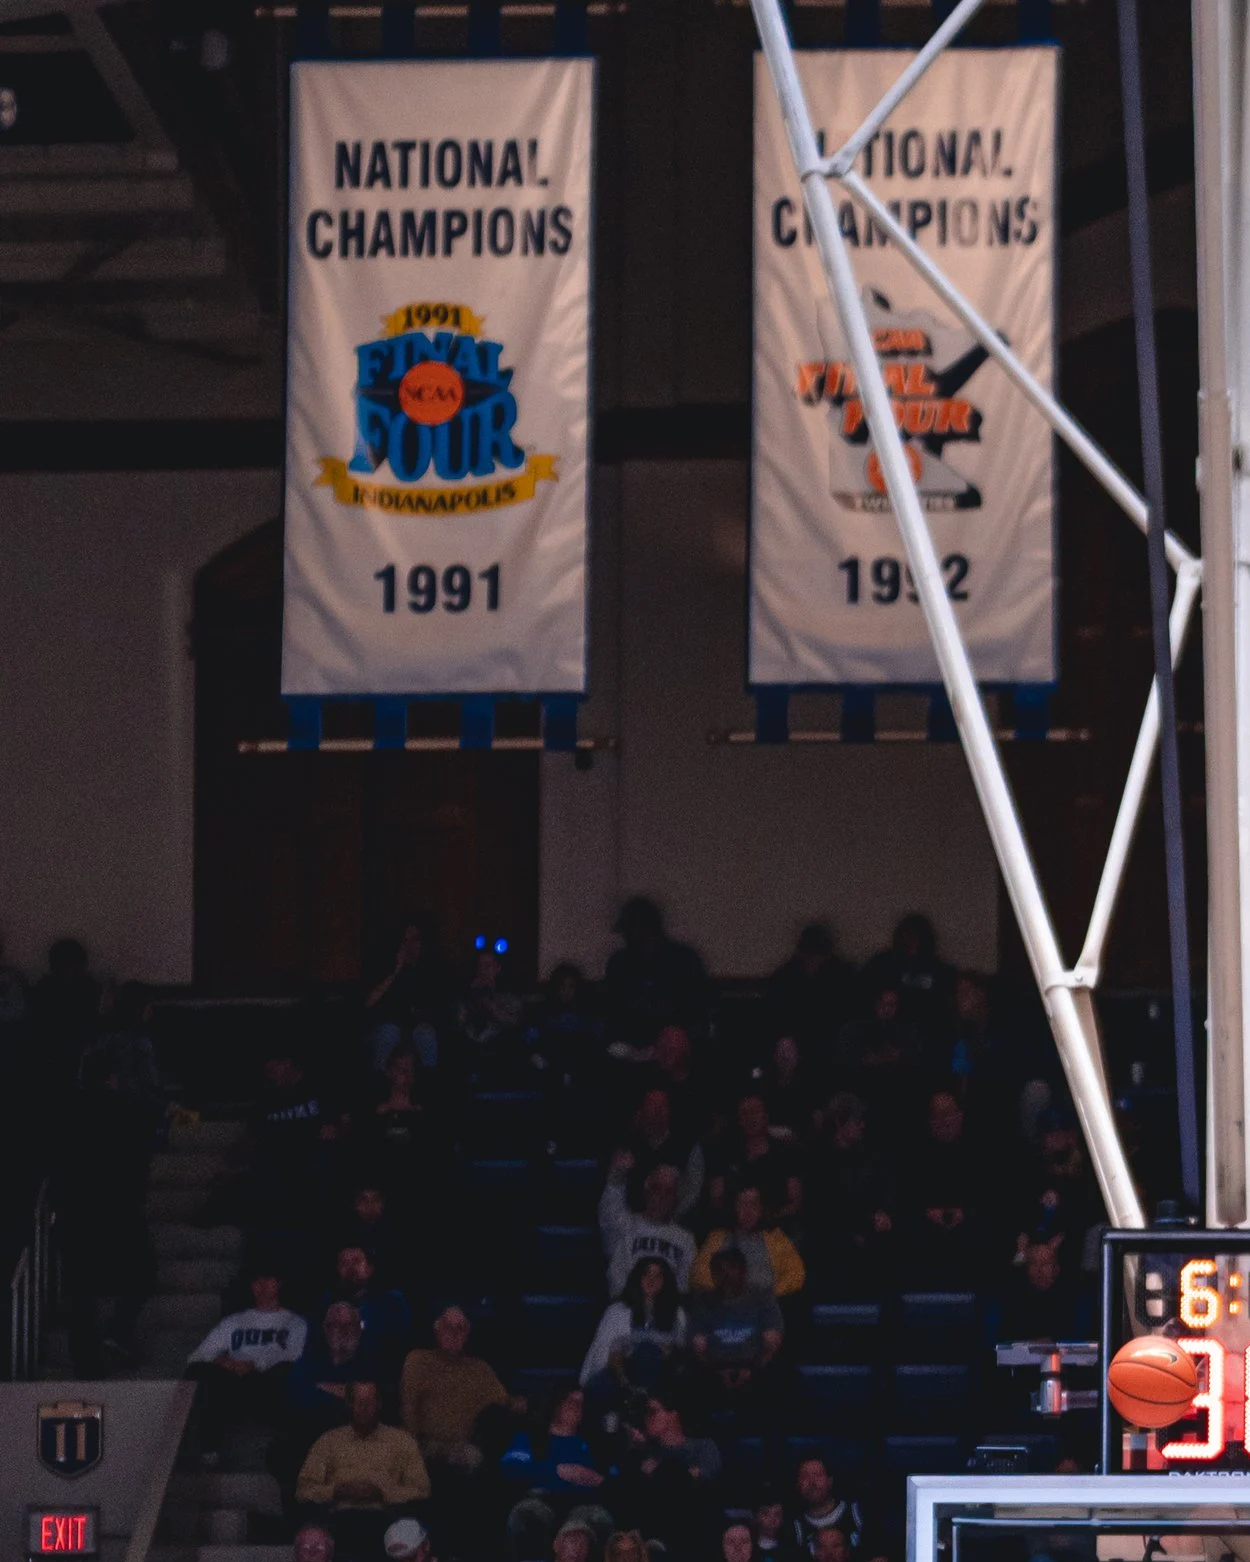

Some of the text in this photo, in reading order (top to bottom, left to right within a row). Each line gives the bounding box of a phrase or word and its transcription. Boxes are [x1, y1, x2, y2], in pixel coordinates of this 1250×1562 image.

[335, 139, 549, 189] NATIONAL
[306, 205, 573, 259] CHAMPIONS
[404, 305, 462, 328] 1991
[355, 332, 504, 386] FINAL
[348, 392, 525, 482] FOUR
[374, 562, 500, 614] 1991
[41, 1515, 87, 1551] EXIT
